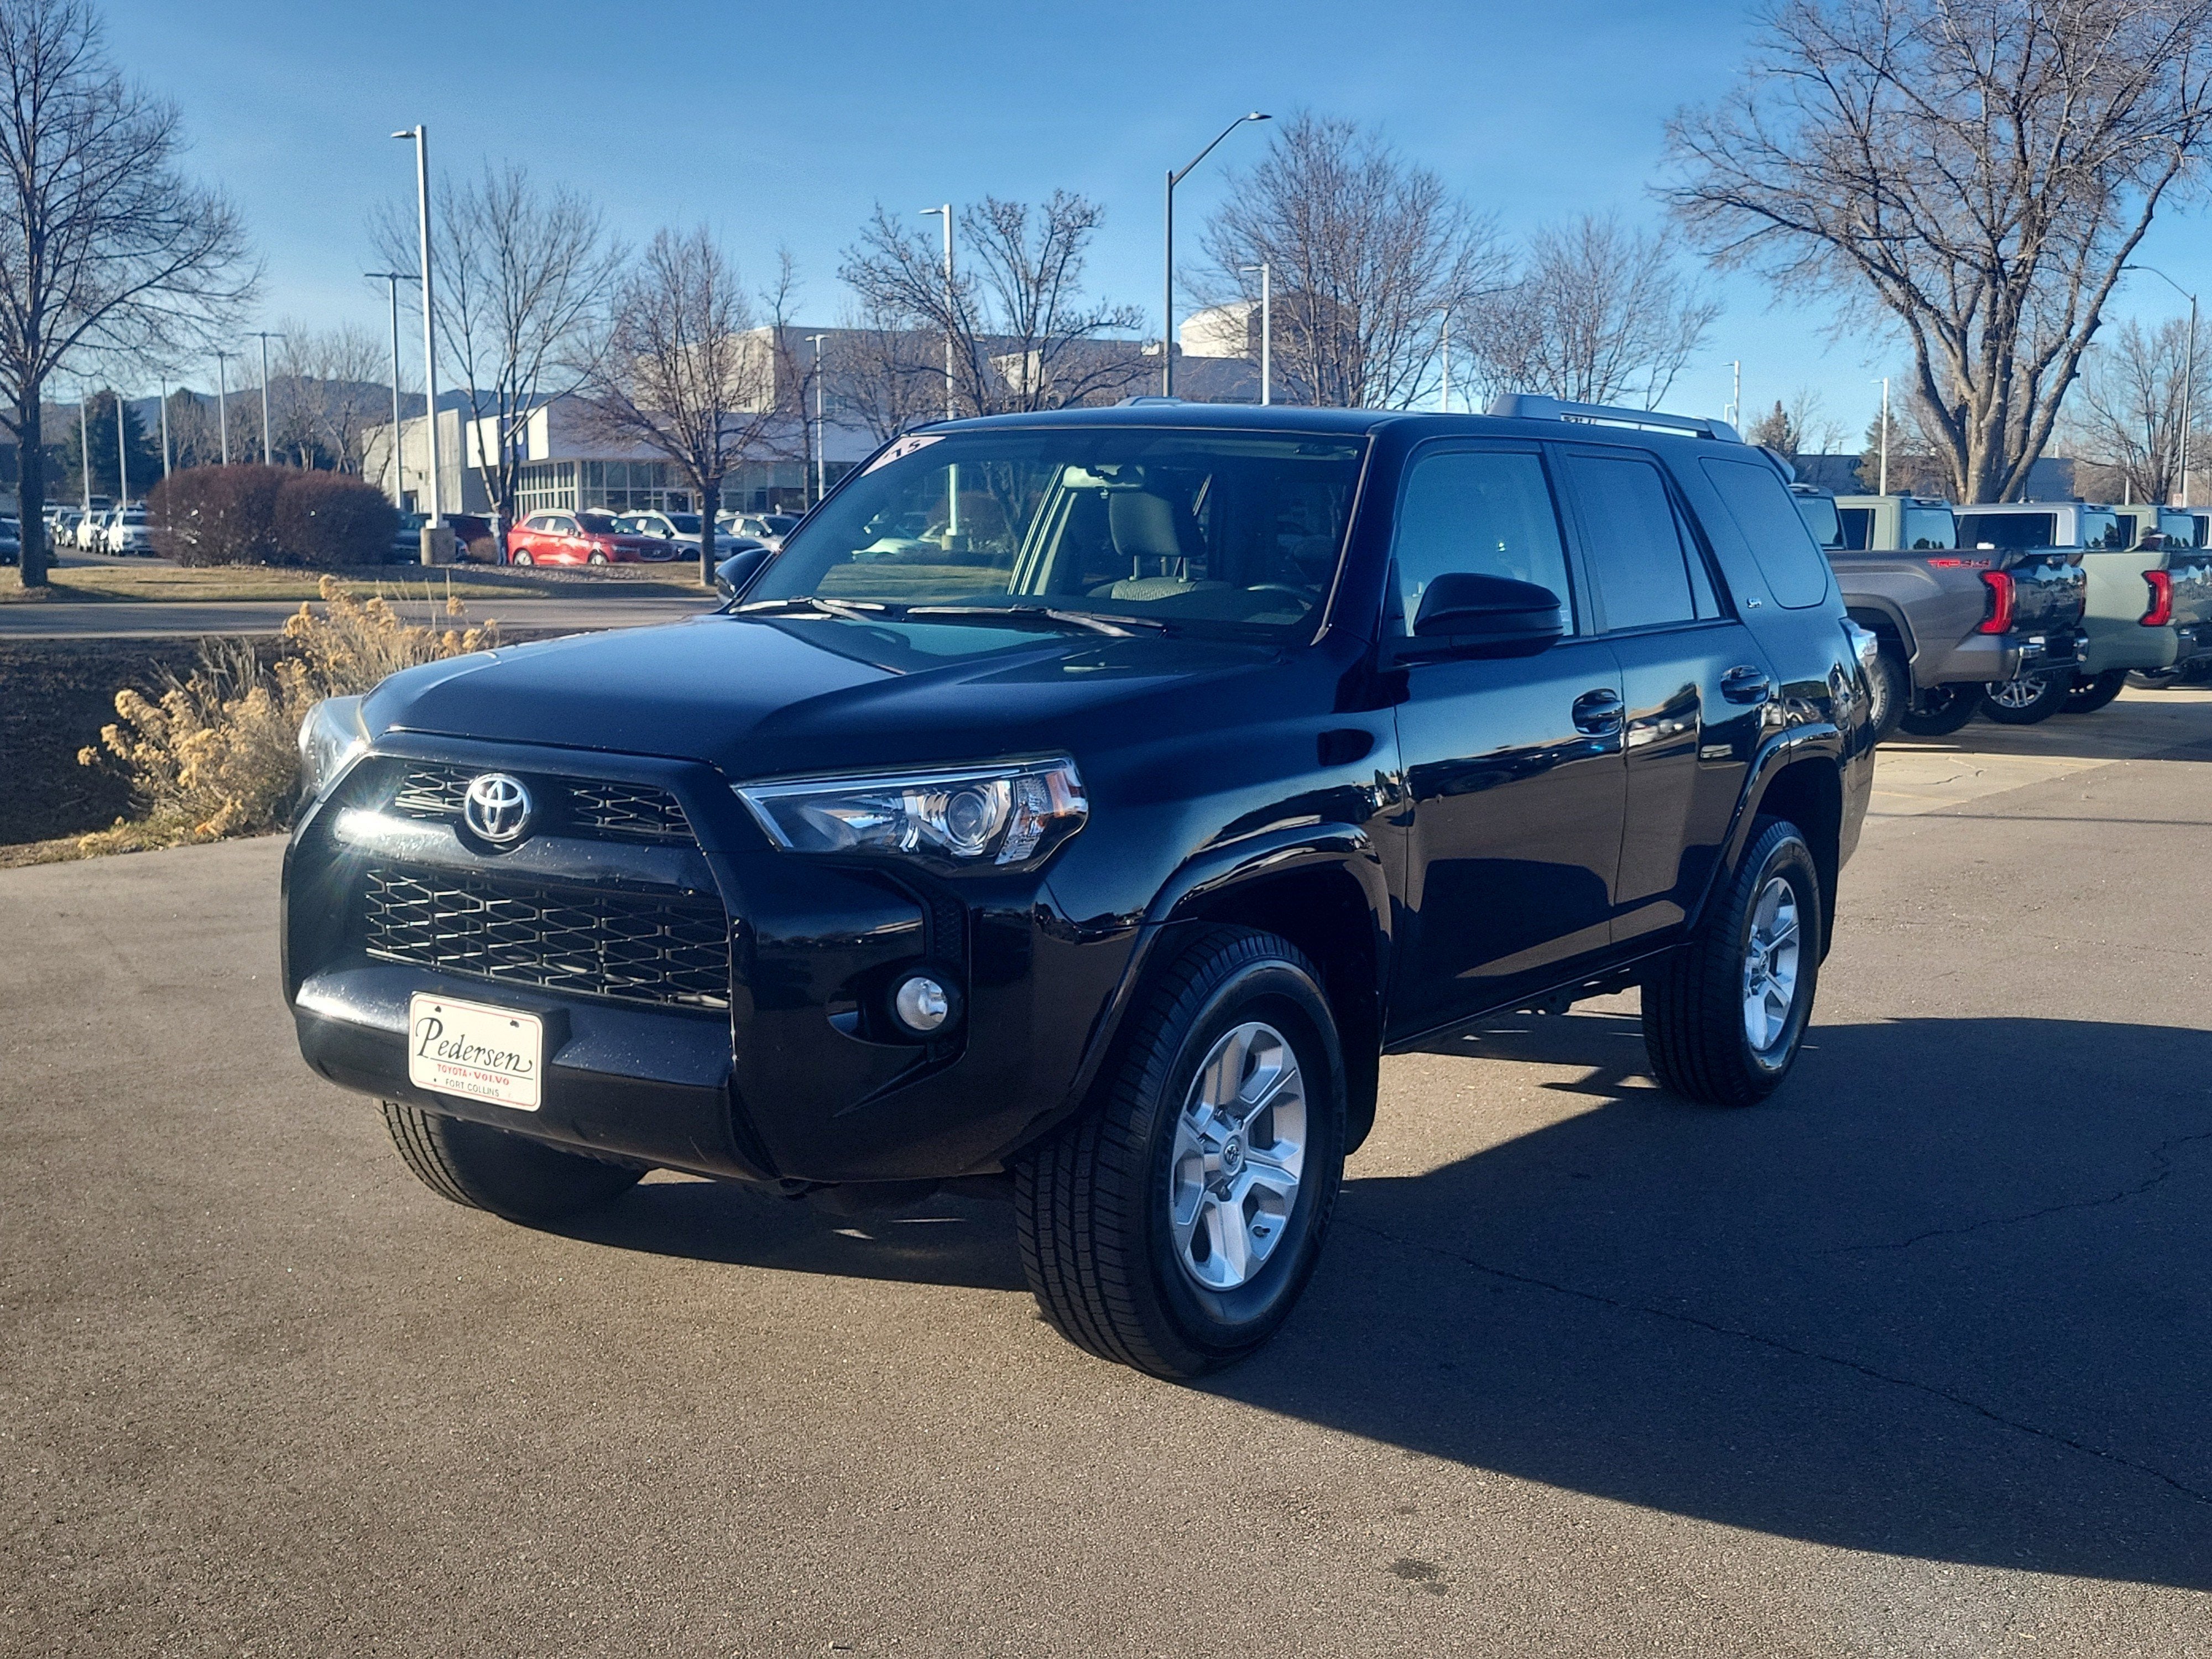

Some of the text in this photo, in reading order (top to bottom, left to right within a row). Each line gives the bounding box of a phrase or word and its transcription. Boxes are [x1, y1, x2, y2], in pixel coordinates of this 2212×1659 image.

[415, 1017, 533, 1073] Pedersen
[437, 1063, 510, 1086] TOYOTA VOLVO
[445, 1078, 499, 1097] FORT COLLINS
